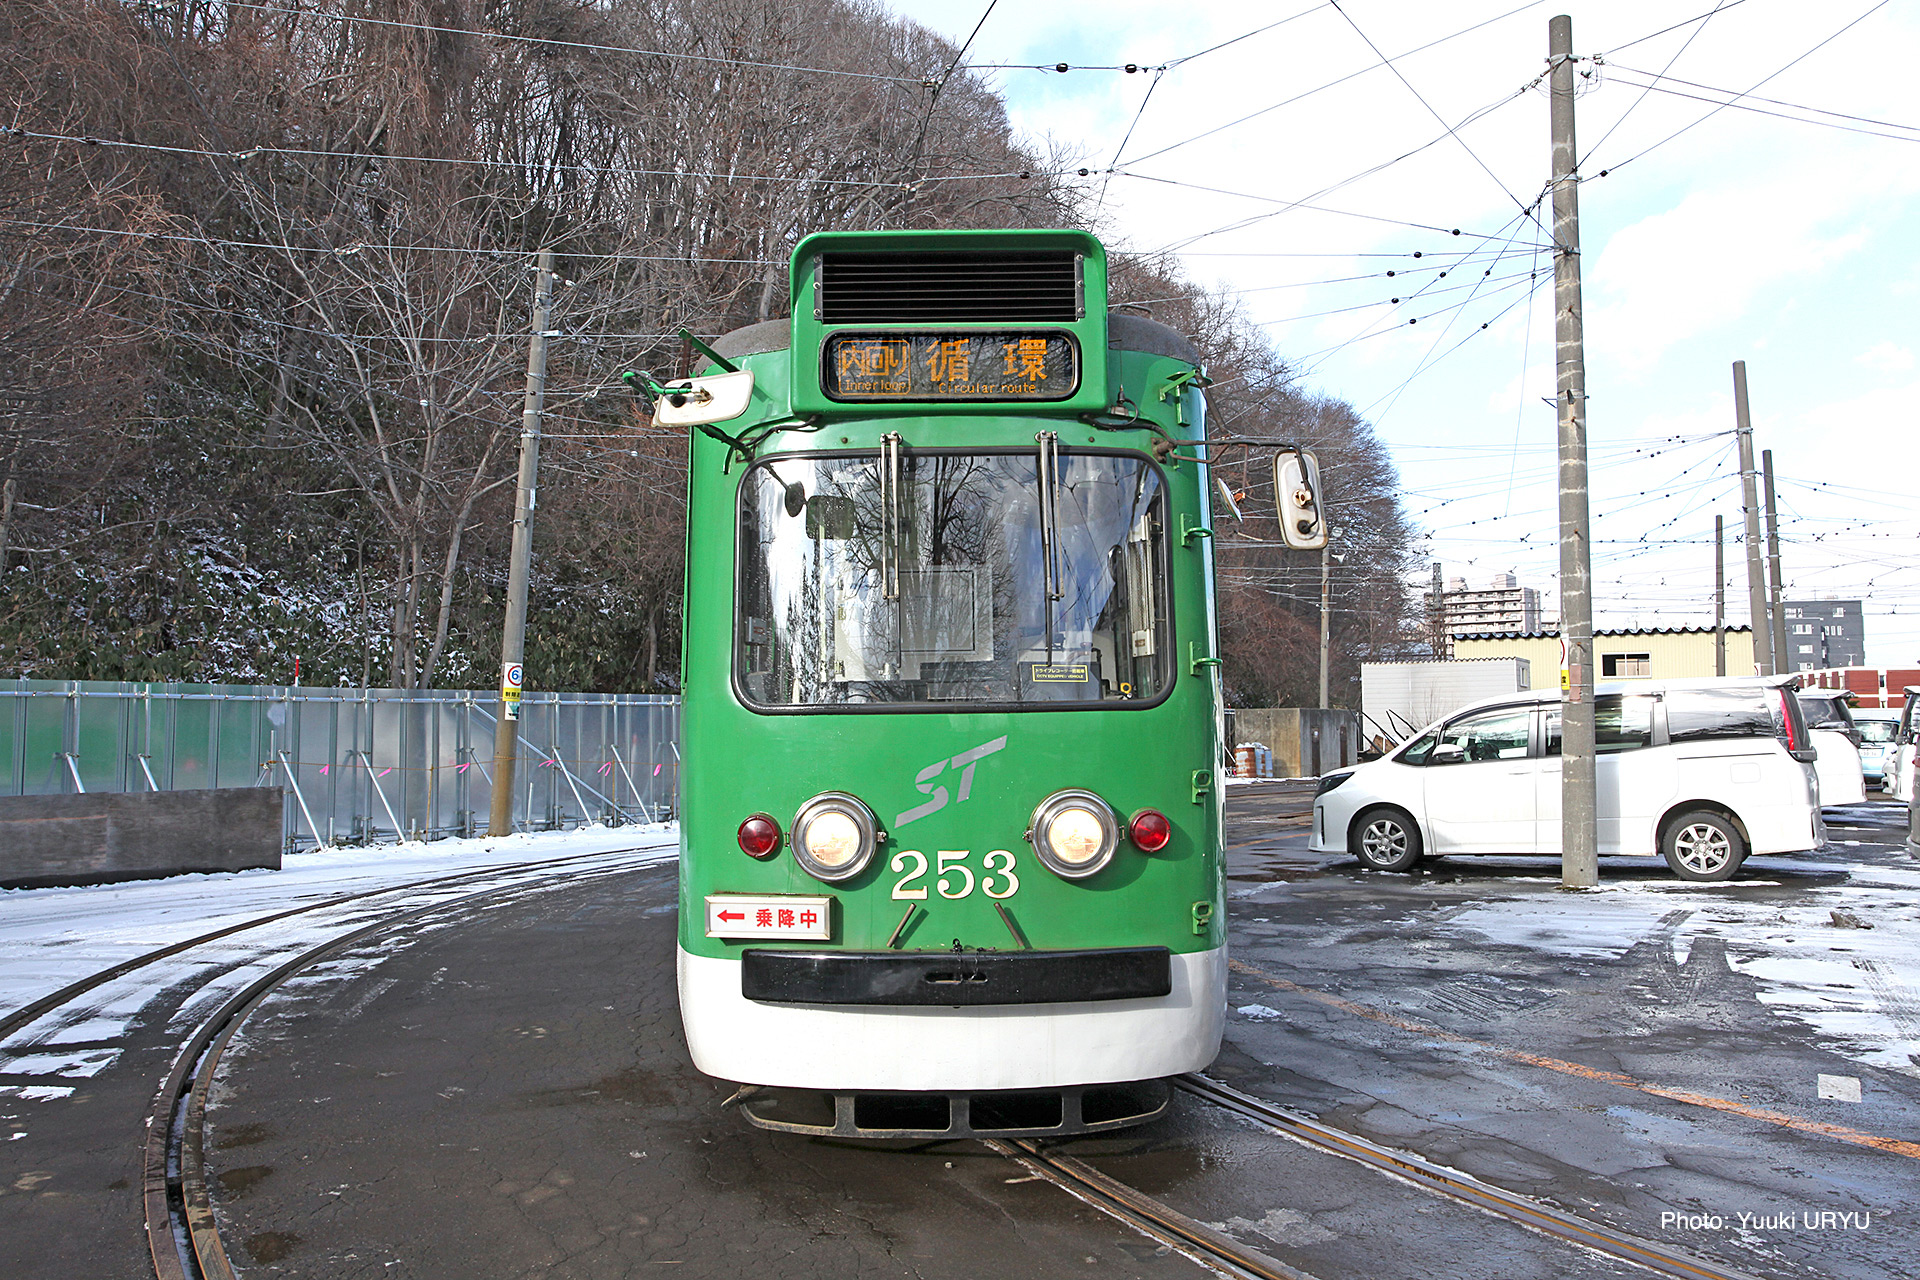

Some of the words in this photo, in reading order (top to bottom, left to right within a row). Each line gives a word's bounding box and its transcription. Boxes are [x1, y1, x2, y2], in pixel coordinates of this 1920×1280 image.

[842, 346, 907, 377] 内回り
[926, 339, 1048, 381] 循環
[845, 380, 878, 391] Inner
[881, 380, 906, 391] loop
[938, 382, 995, 394] Circular
[1001, 383, 1036, 394] route
[894, 734, 1008, 829] ST
[891, 850, 1020, 900] 253
[755, 908, 817, 929] 乗降中
